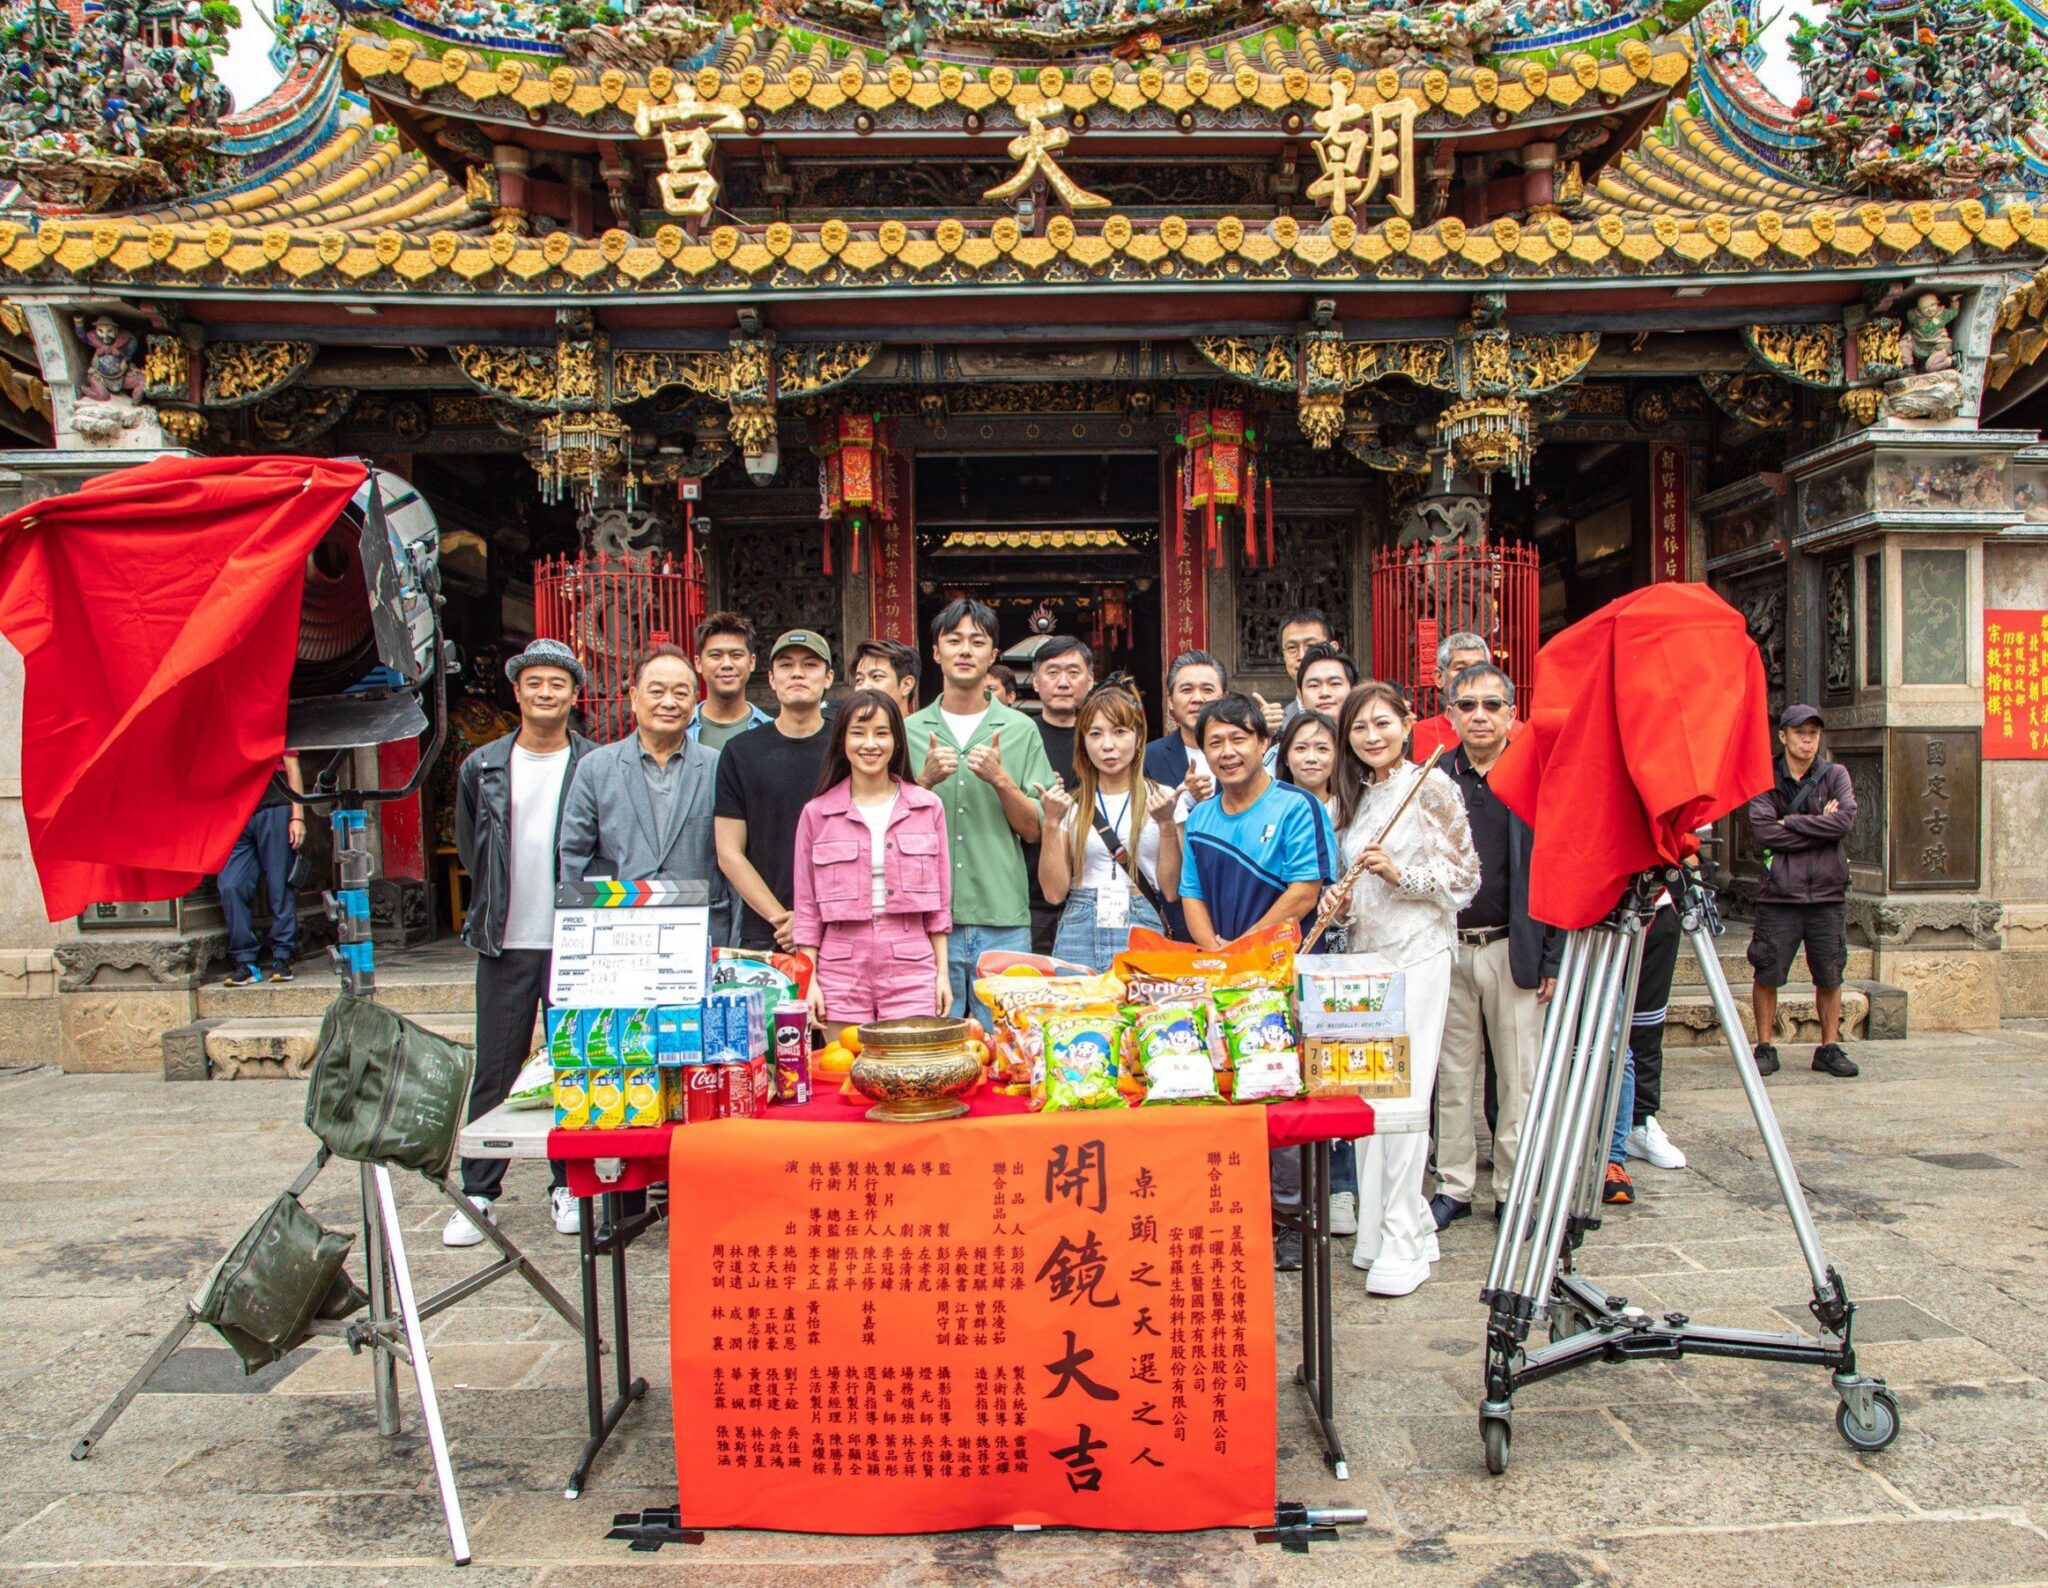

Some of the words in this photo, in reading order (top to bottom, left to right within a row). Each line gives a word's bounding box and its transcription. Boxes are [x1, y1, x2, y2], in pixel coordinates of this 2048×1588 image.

[1987, 623, 2002, 716] 宗教楷模
[2015, 631, 2026, 707] 榮獲內政部
[2029, 633, 2040, 751] 北港朝天宮
[1921, 739, 1949, 875] 國定古蹟
[1126, 980, 1205, 1001] Doritos
[1035, 1139, 1120, 1493] 開鏡大吉
[1129, 1167, 1165, 1467] 桌頭之天選之人
